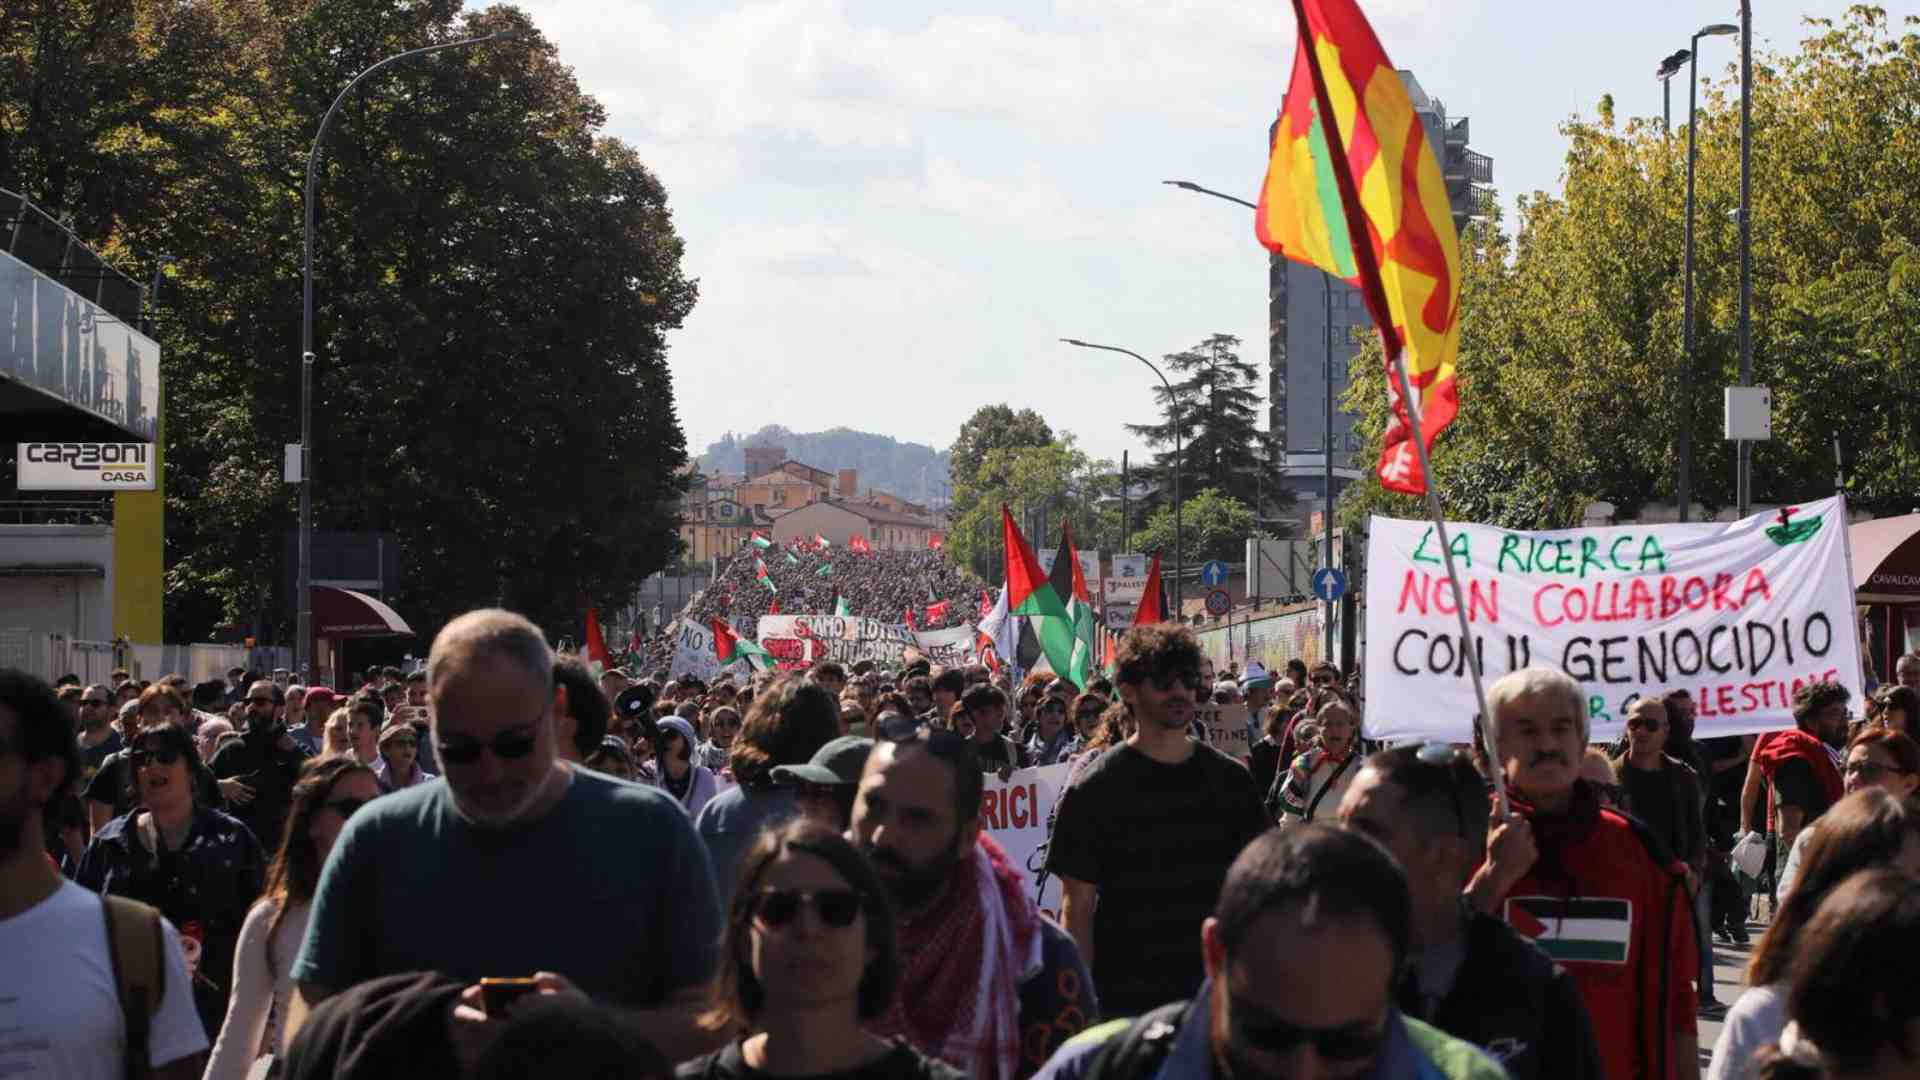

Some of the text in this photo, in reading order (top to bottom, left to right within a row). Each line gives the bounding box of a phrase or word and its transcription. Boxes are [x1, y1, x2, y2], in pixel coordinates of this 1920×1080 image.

[102, 472, 146, 482] CASA
[1412, 526, 1666, 578] LA RICERCA
[1397, 566, 1772, 628] NON COLLABORA
[680, 624, 704, 651] NO
[1393, 628, 1484, 678] CON
[1561, 611, 1832, 685] GENOCIDIO
[1690, 668, 1838, 717] LESTI
[981, 783, 1039, 830] RICI
